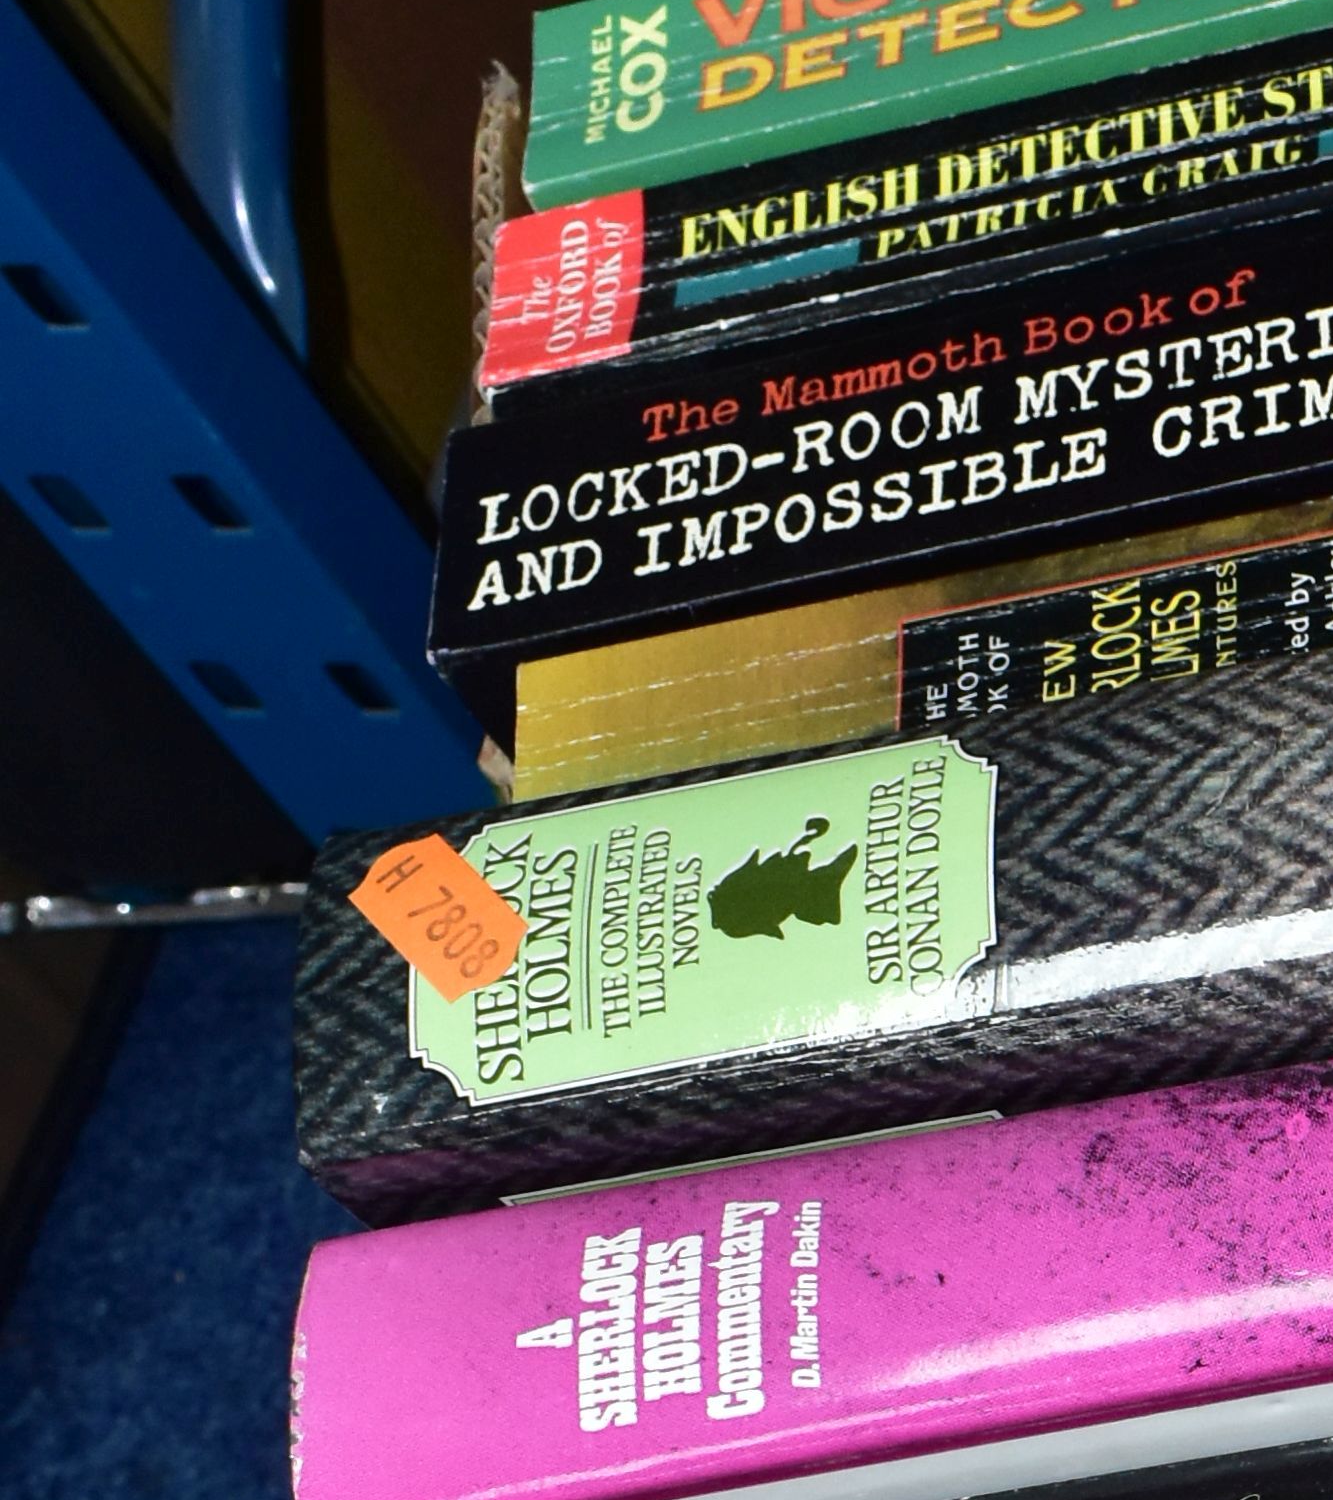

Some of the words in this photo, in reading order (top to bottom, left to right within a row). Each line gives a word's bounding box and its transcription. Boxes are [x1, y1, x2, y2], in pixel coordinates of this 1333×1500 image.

[583, 13, 613, 146] MICHAEL
[613, 4, 668, 134] COX
[680, 162, 920, 263] ENGLISH
[936, 80, 1247, 200] DETECTIVE
[875, 176, 1119, 260] PATRICIA
[1139, 133, 1302, 197] CRAIG
[642, 398, 741, 445] The
[761, 330, 1007, 417] Mammoth
[1023, 290, 1175, 360] Book
[1190, 268, 1256, 317] of
[466, 537, 604, 613] AND
[633, 426, 1109, 579] IMPOSSIBLE
[475, 386, 982, 548] LOCKED-ROOM
[866, 775, 906, 933] ARTHUR
[907, 754, 949, 871] DOYLE
[376, 854, 426, 896] H
[405, 884, 502, 981] 7808
[599, 823, 639, 984] COMPLETE
[634, 827, 674, 1018] ILLUSTRATED
[671, 856, 704, 967] NOVELS
[868, 933, 902, 985] SIR
[905, 875, 944, 998] CONAN
[601, 986, 631, 1040] THE
[515, 1317, 575, 1350] A
[577, 1226, 643, 1434] SHERLOCK
[642, 1234, 705, 1402] HOLMES
[705, 1199, 781, 1421] Commentary
